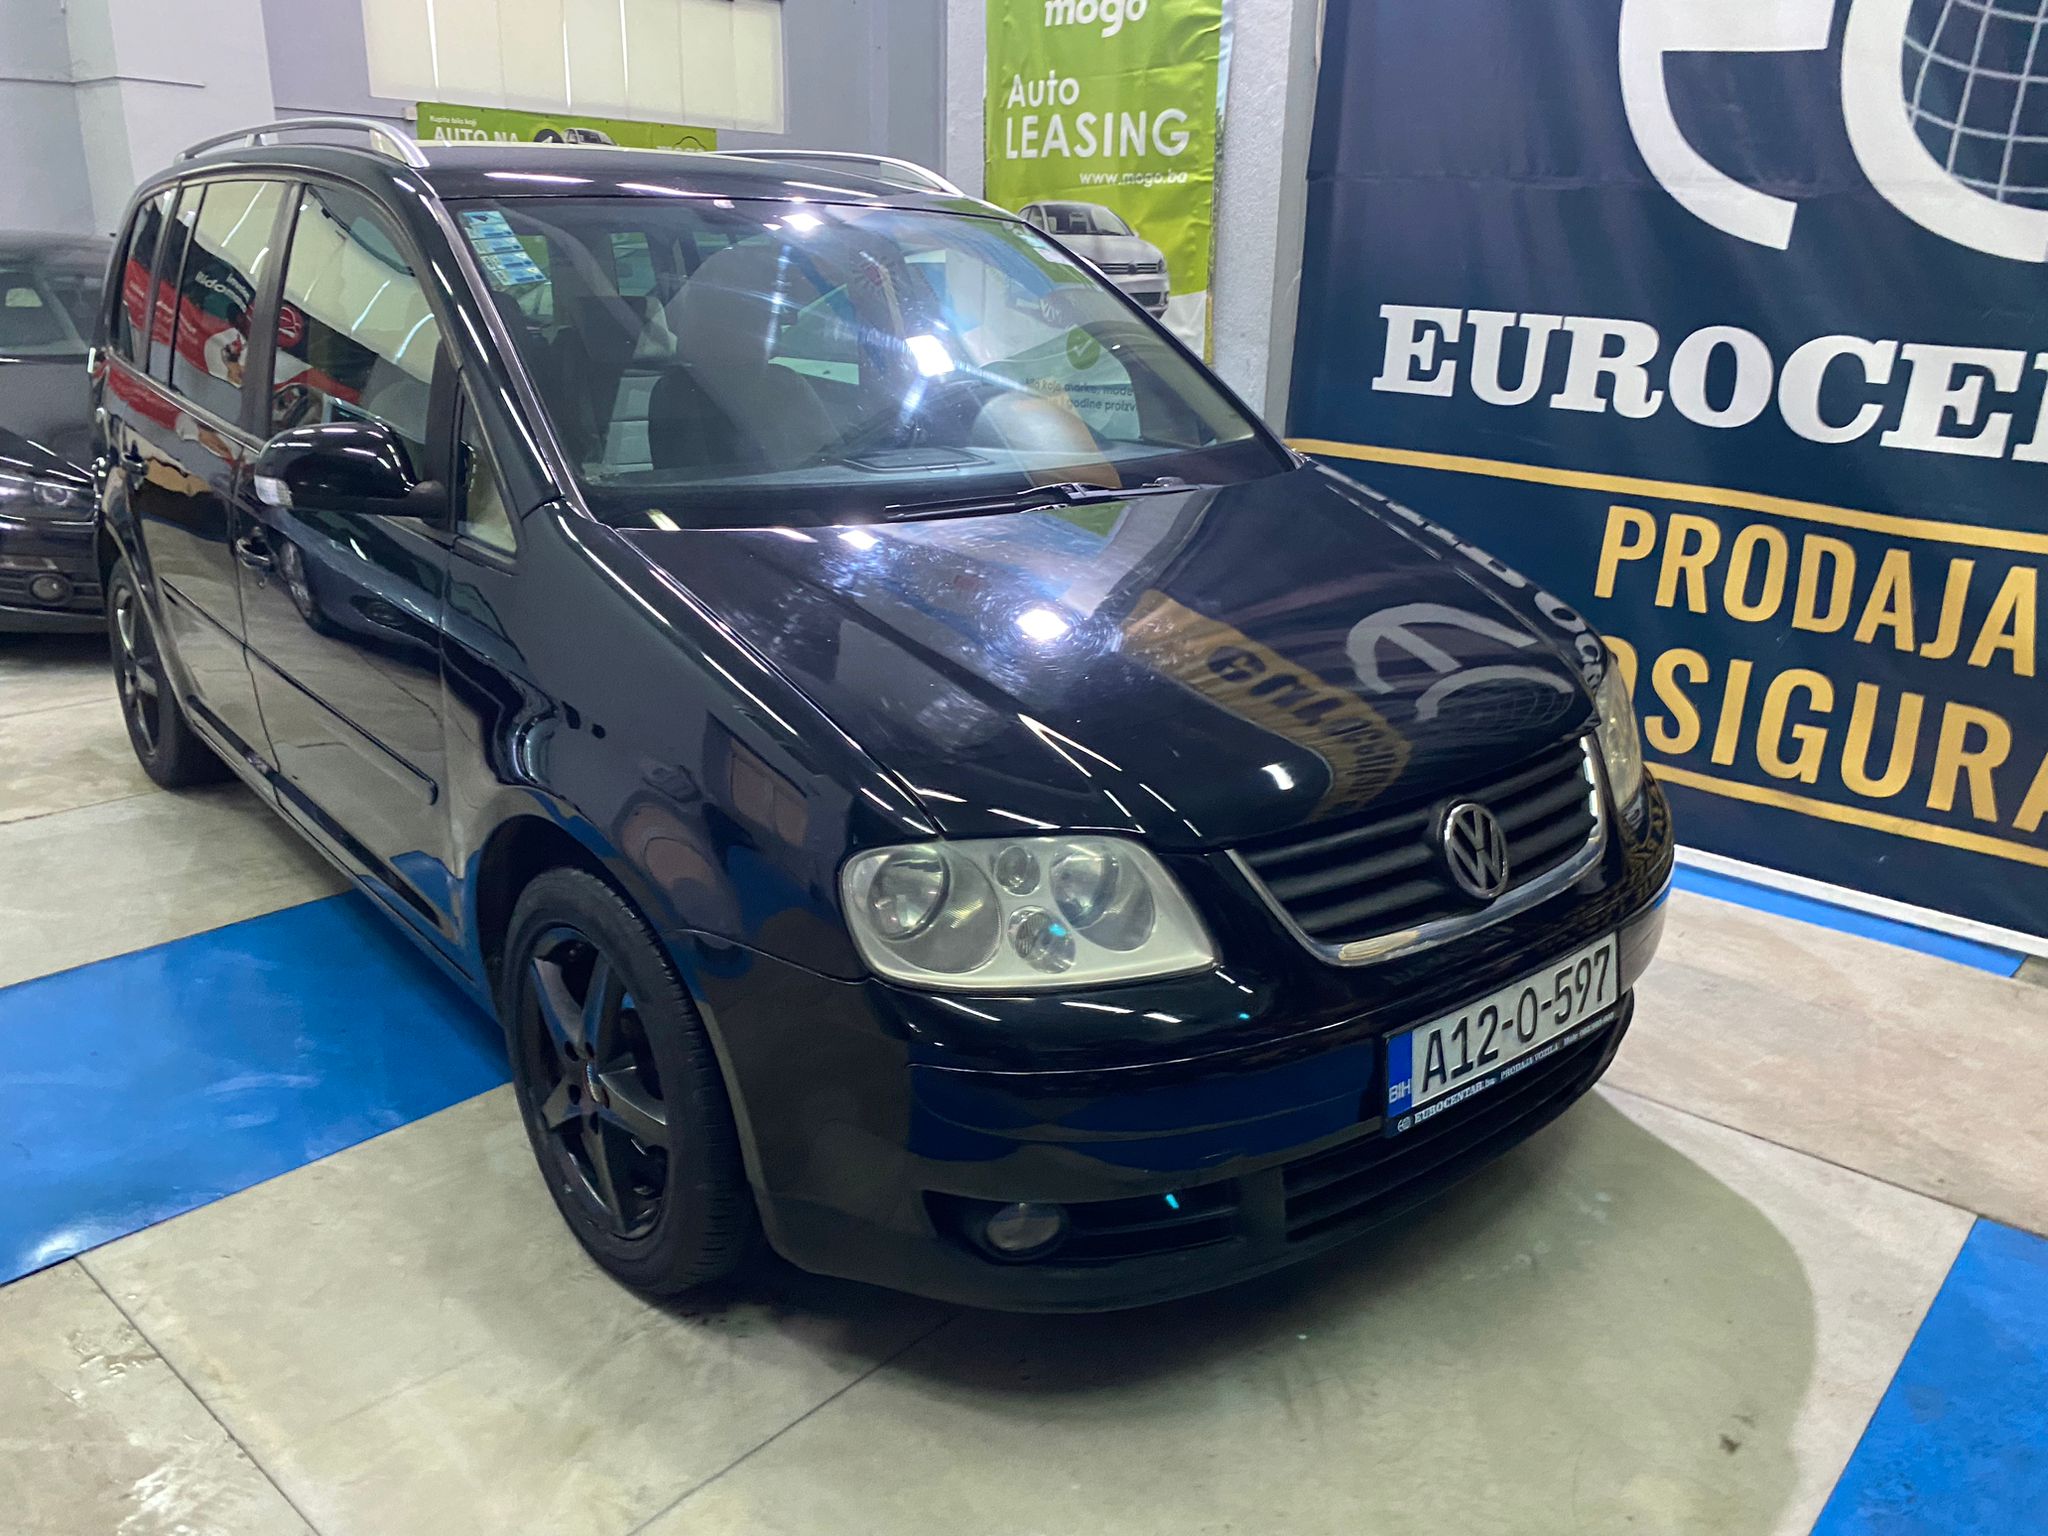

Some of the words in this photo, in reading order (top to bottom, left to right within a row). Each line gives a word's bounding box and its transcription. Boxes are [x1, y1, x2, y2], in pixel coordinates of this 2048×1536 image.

[1043, 0, 1148, 38] mogo
[1006, 70, 1080, 109] Auto
[1005, 108, 1190, 160] LEASING
[1079, 170, 1188, 188] www.mogo.ba
[1593, 505, 2038, 677] PRODAJA
[1388, 1079, 1411, 1103] BIH
